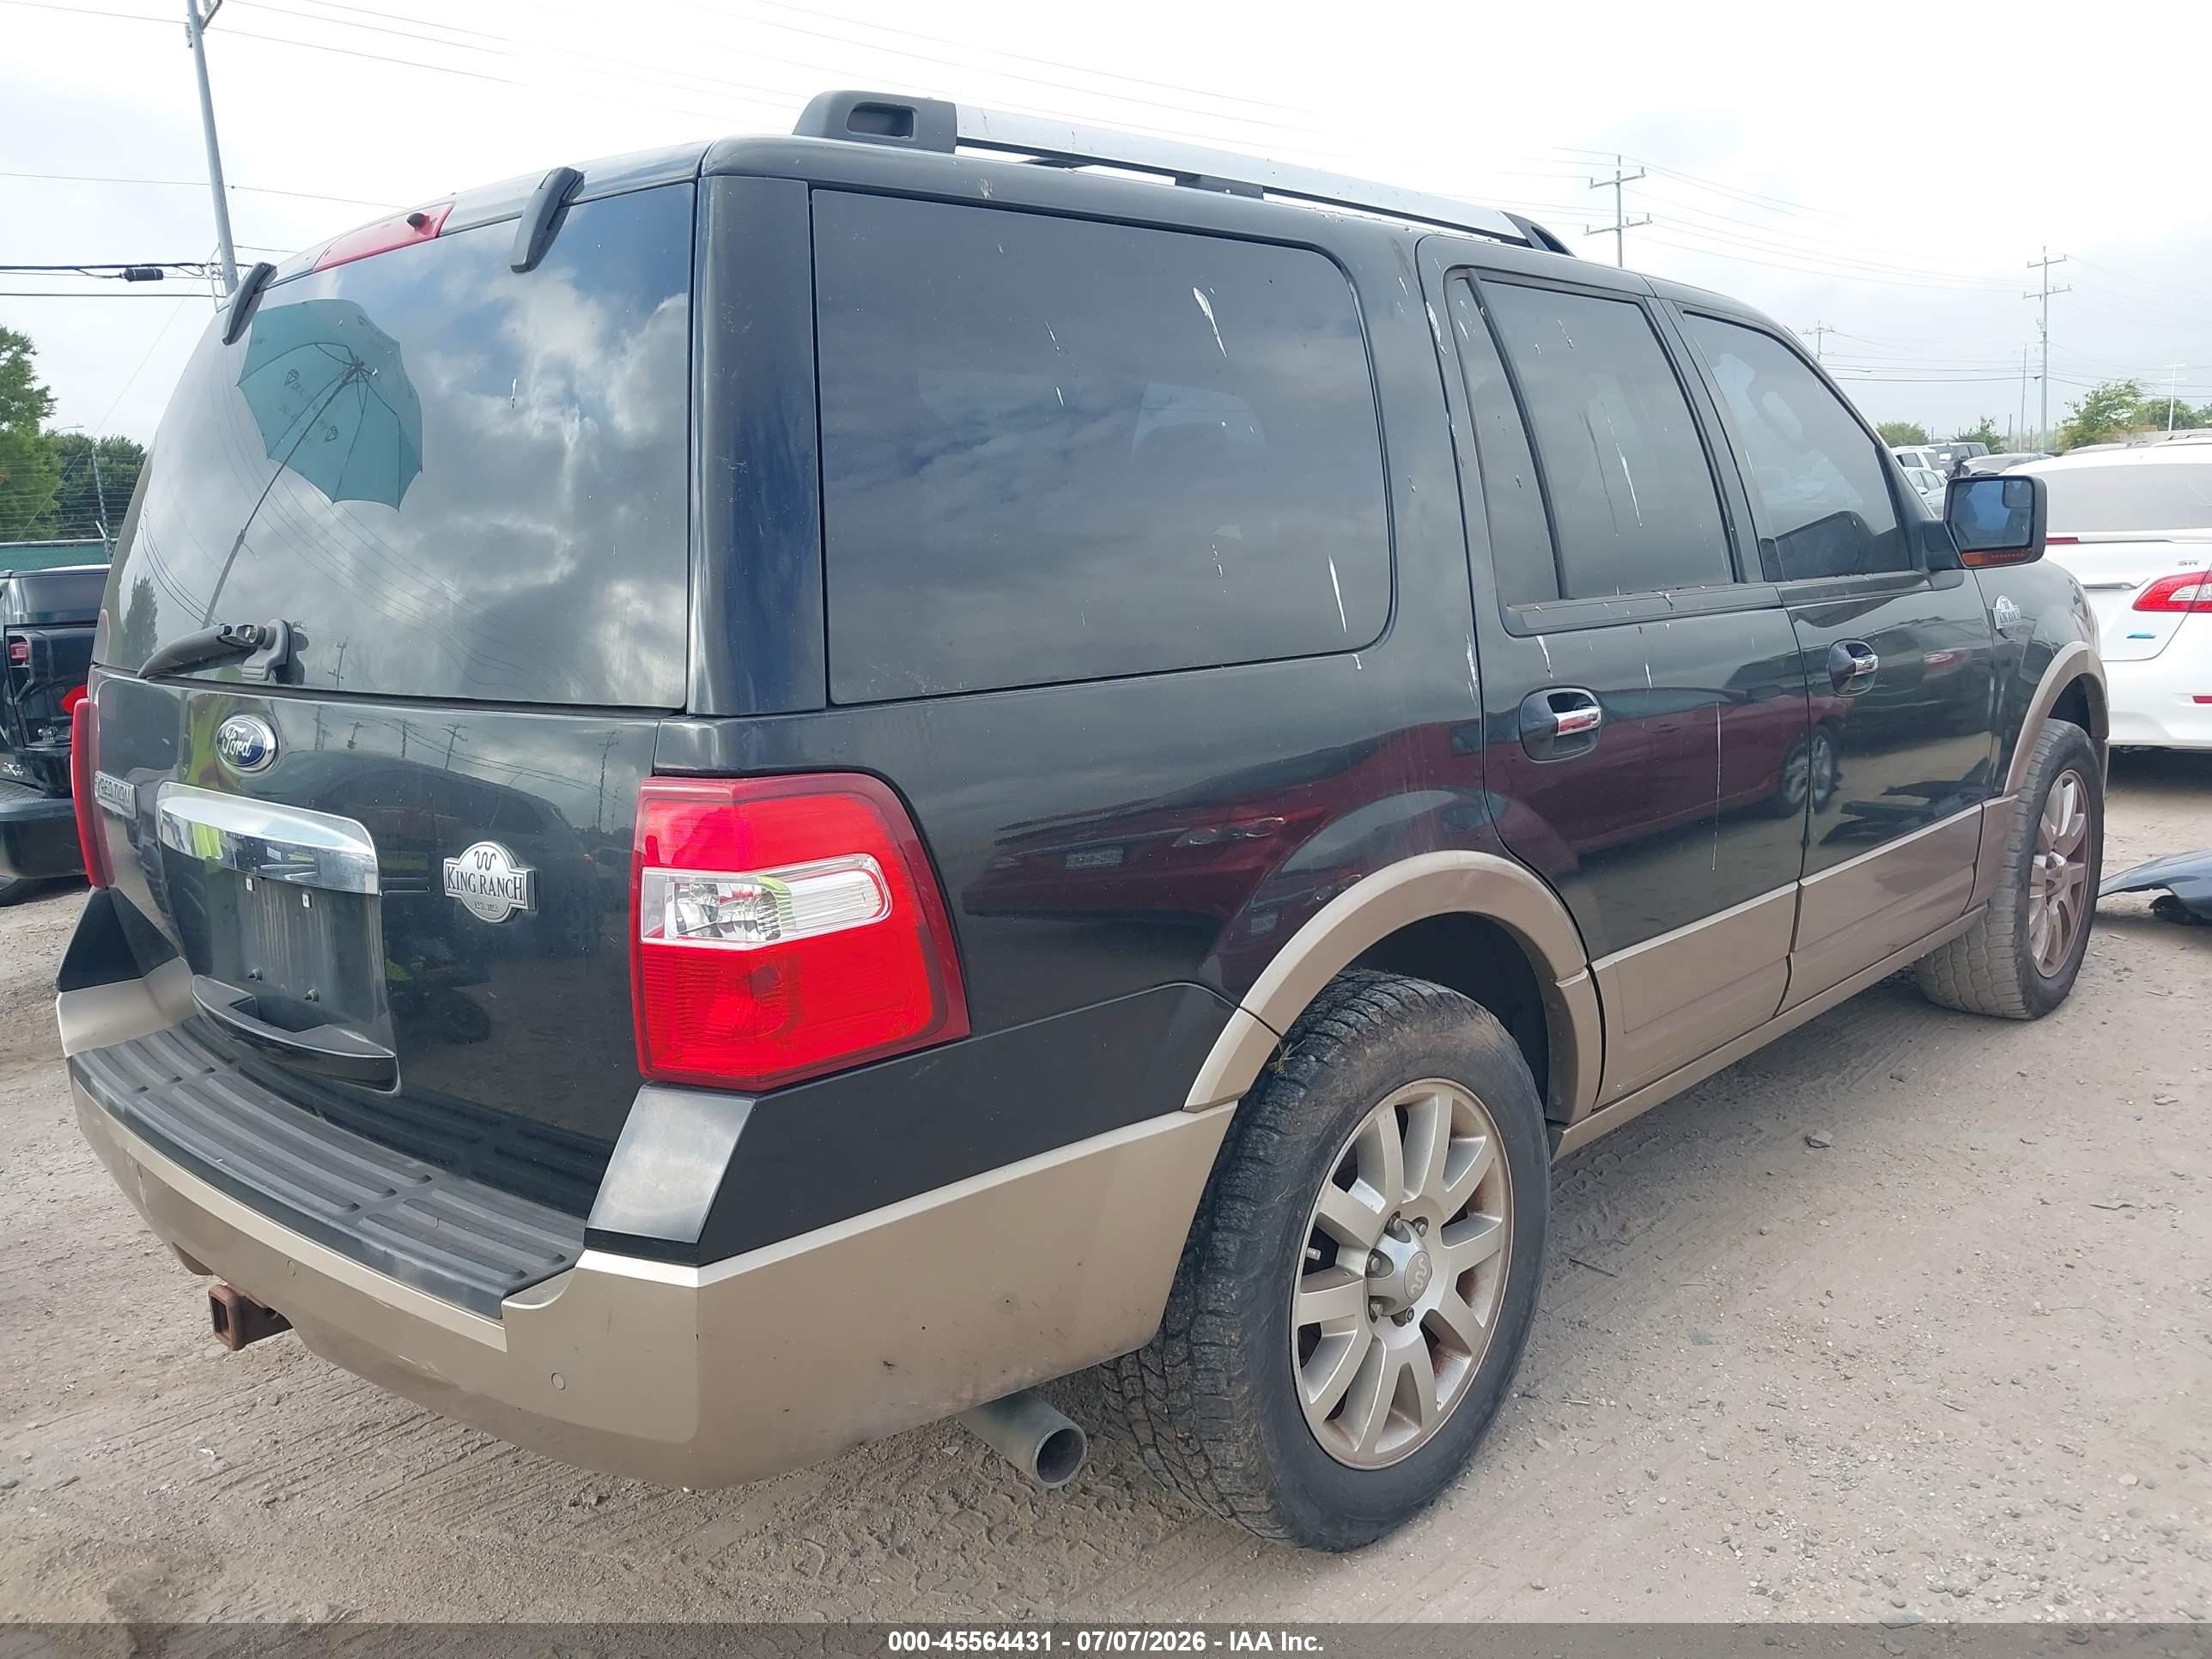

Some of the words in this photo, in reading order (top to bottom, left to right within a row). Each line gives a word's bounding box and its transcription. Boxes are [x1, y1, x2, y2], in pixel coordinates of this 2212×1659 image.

[222, 725, 254, 757] Ford
[447, 866, 476, 893] KING
[479, 874, 523, 901] RANCH
